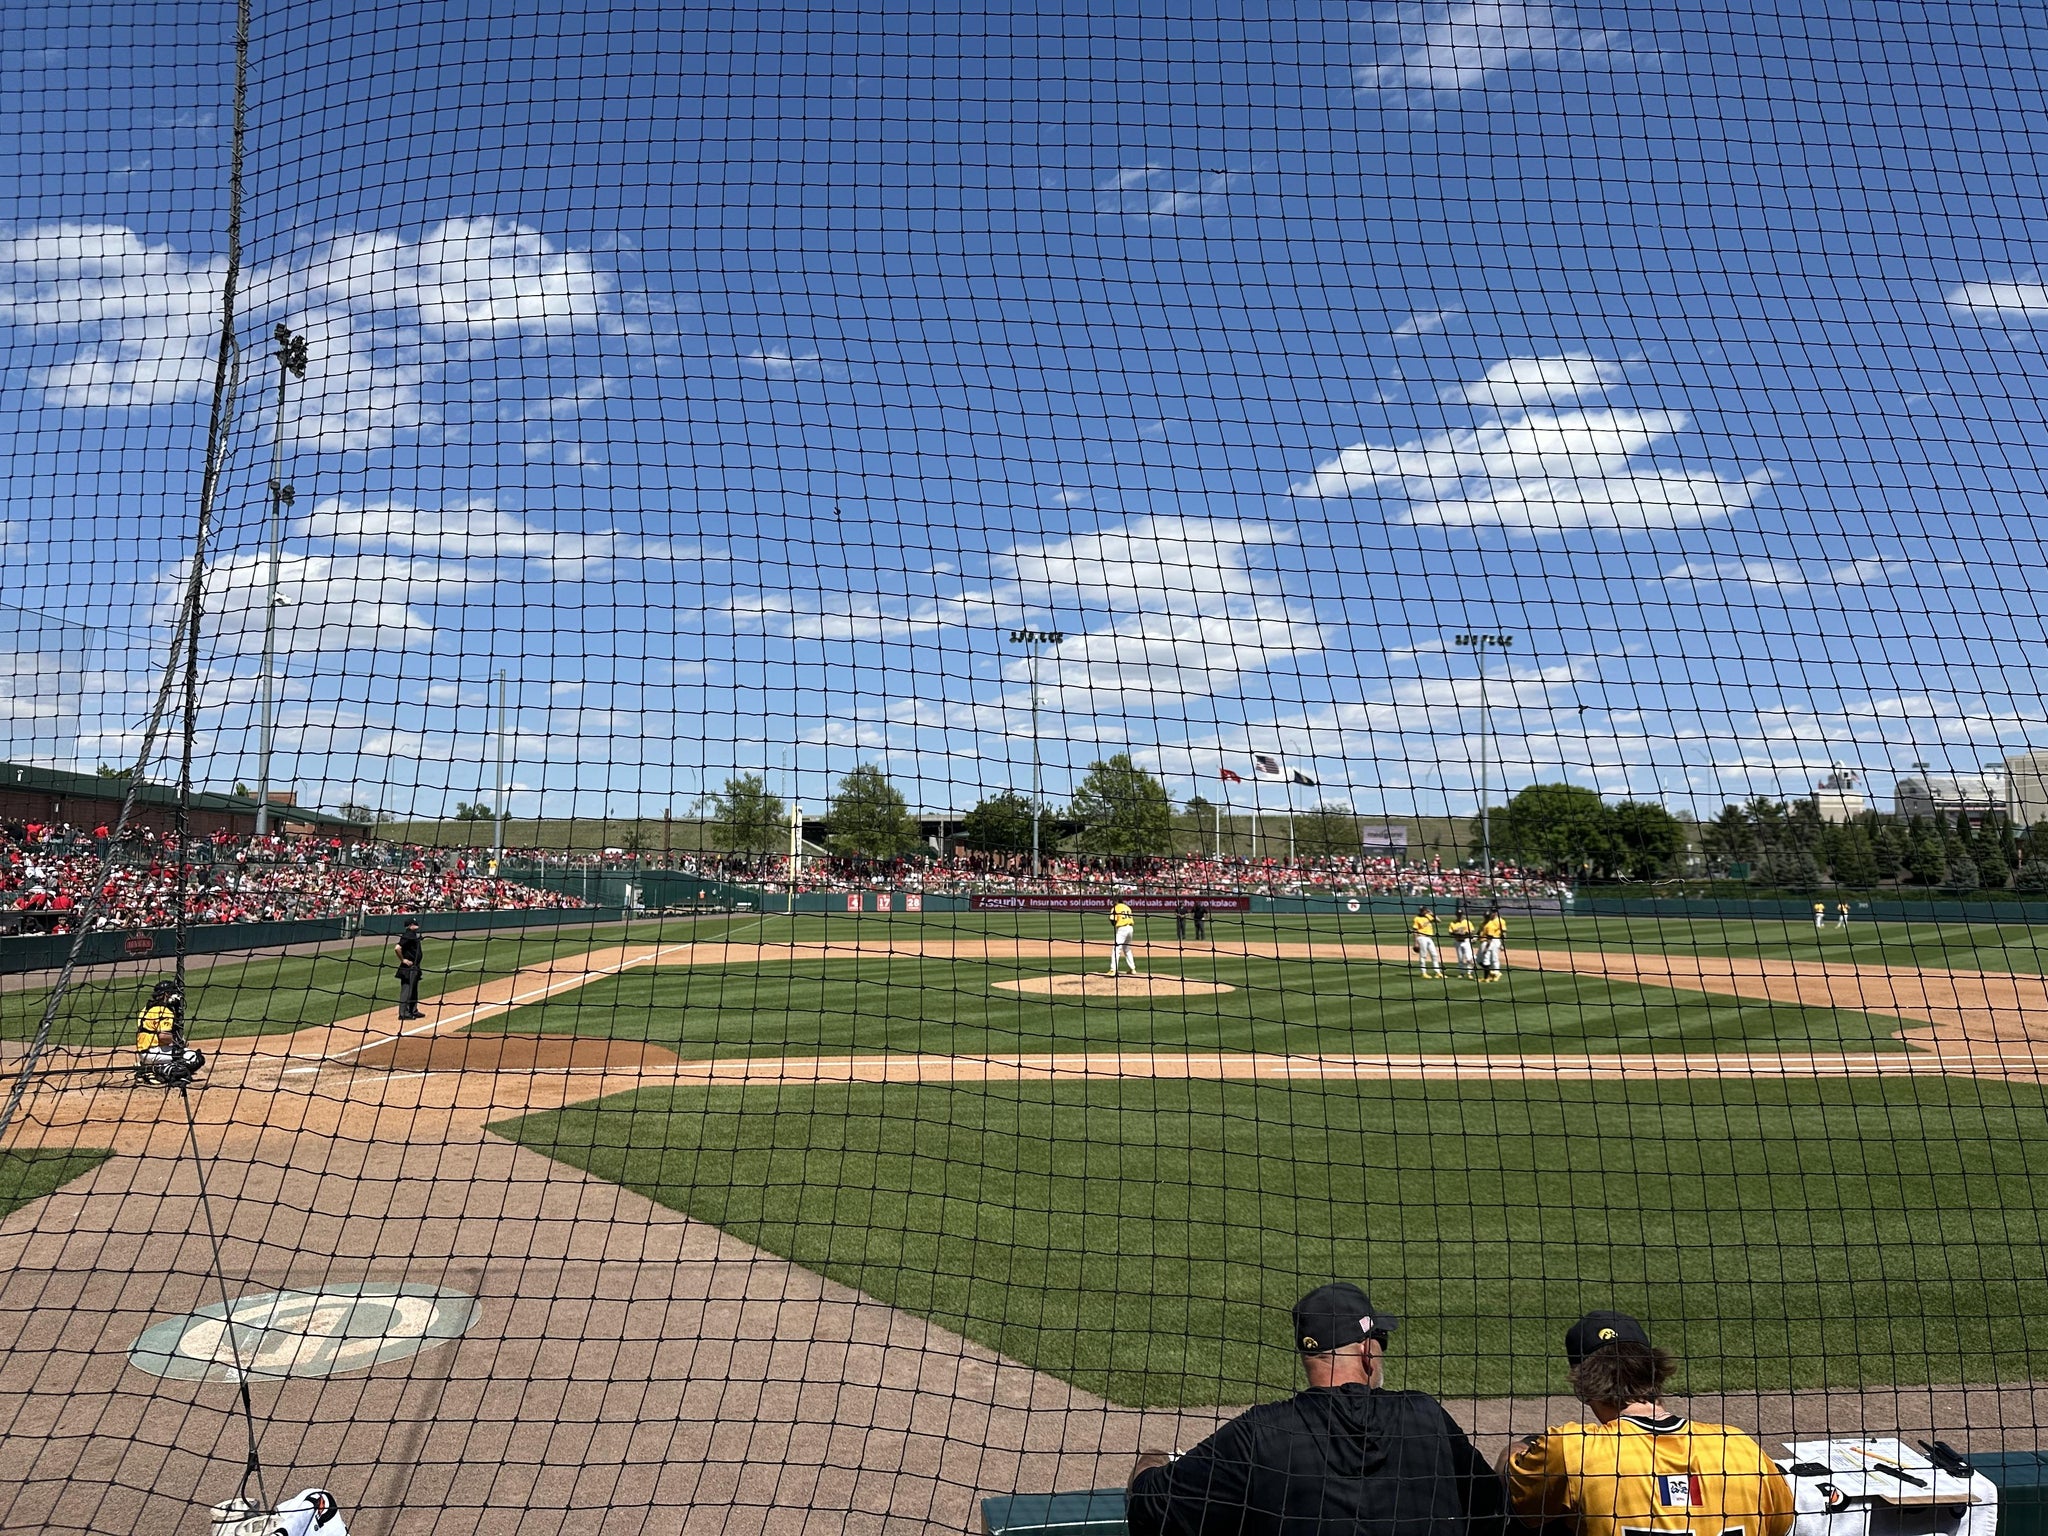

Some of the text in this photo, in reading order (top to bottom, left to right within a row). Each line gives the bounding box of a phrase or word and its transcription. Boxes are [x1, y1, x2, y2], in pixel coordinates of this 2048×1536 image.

[851, 898, 860, 907] 4
[879, 898, 891, 907] 17
[907, 898, 920, 907] 28
[979, 896, 1025, 909] Assurity
[1030, 898, 1068, 906] Insurance
[1069, 897, 1105, 906] solutions
[1121, 897, 1163, 907] ndividuals
[1164, 897, 1180, 907] and
